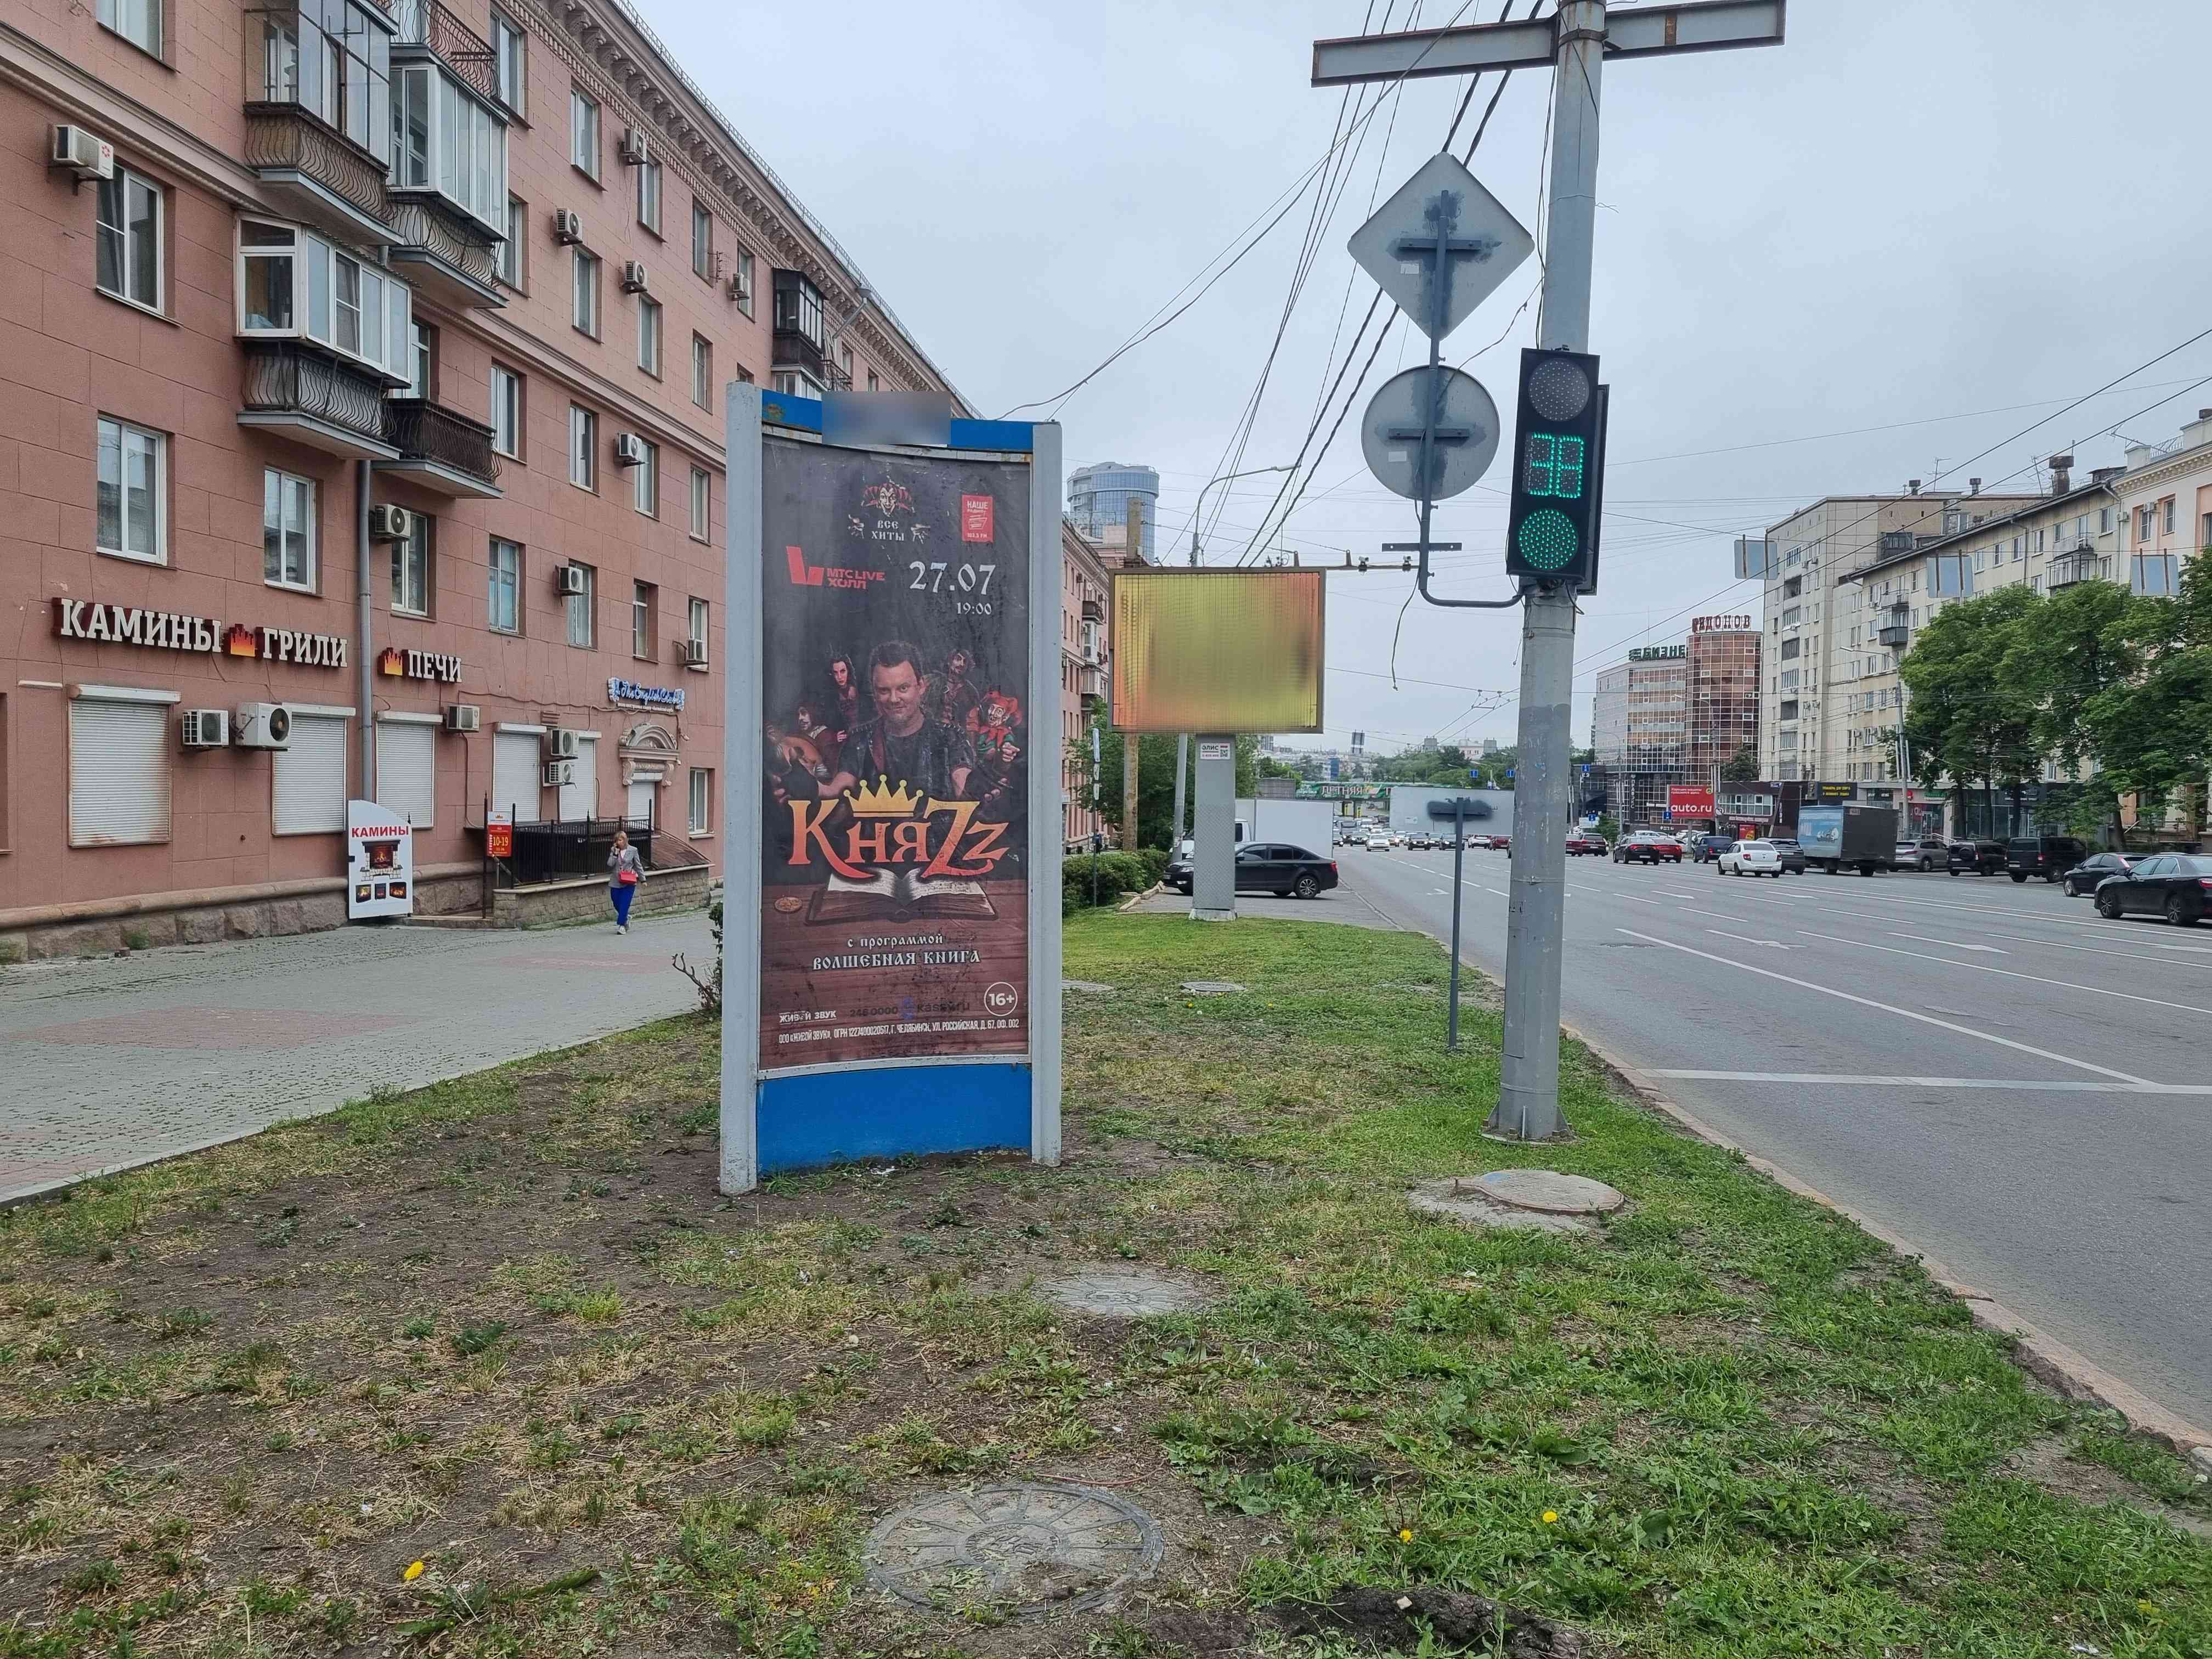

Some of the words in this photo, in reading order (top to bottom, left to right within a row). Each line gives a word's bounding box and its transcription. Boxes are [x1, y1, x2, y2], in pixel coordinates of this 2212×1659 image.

[1530, 431, 1584, 499] 38
[967, 500, 989, 509] НАШЕ
[871, 531, 905, 541] ХИТЫ
[827, 568, 853, 579] МТС
[854, 570, 887, 582] LIVE
[909, 561, 996, 595] 27.07
[827, 577, 867, 590] ХОЛЛ
[956, 602, 992, 615] 19:00
[60, 598, 222, 653] КАМИНЫ
[262, 627, 348, 668] ГРИЛИ
[408, 649, 462, 683] ПЕЧИ
[1643, 645, 1688, 659] БИЗНЕ
[1321, 785, 1363, 795] ЛЕТНЯЯ
[1670, 803, 1712, 812] auto.ru
[351, 826, 409, 838] КАМИНЫ
[493, 836, 509, 846] 10-19
[847, 938, 854, 947] с
[860, 933, 943, 950] программой
[812, 952, 916, 970] ВОЛШЕБНАЯ
[923, 950, 981, 964] КНИГА
[988, 992, 1014, 1006] 16+
[779, 1011, 811, 1023] ЖИВОЙ
[814, 1010, 837, 1020] ЗВУК
[778, 1034, 789, 1044] ООО
[834, 1028, 848, 1038] ОГРН
